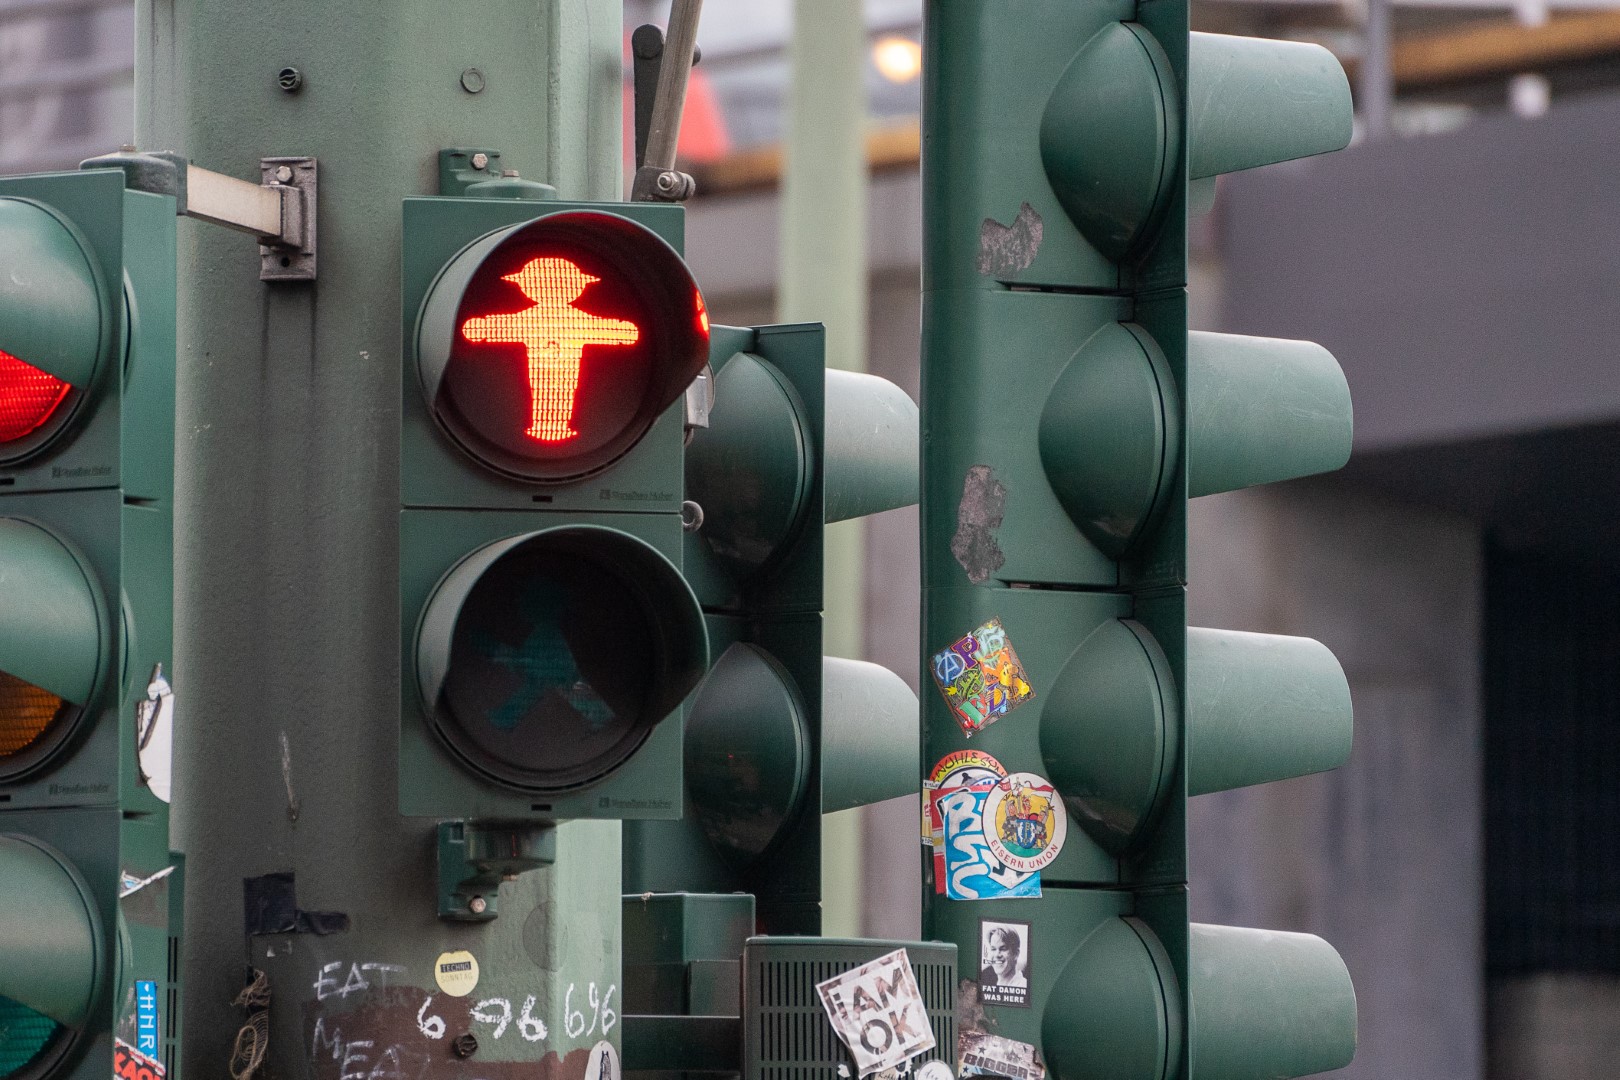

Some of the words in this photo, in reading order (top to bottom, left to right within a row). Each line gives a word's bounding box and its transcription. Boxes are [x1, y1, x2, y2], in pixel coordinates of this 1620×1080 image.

[991, 840, 1024, 868] EISERN
[1029, 844, 1058, 869] UNION
[440, 961, 471, 972] TECHNO
[313, 962, 408, 1000] EAT
[982, 985, 997, 993] FAT
[999, 986, 1027, 996] DAMON
[984, 993, 1001, 1001] WAS
[1003, 995, 1025, 1004] HERE
